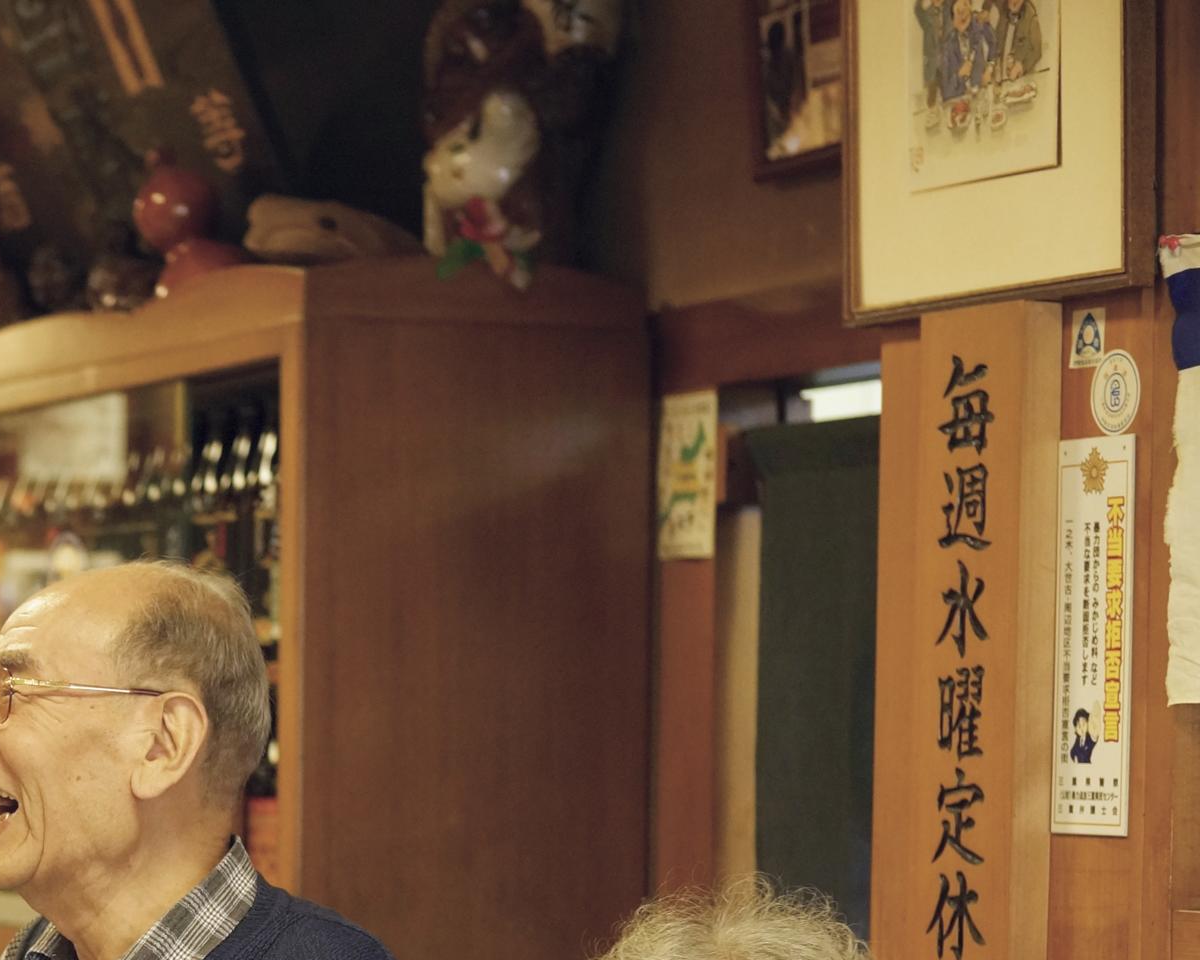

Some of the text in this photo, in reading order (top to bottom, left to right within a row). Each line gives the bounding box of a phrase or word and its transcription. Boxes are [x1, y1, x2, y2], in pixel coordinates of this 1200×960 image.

[1104, 496, 1125, 742] 不当要求拒否宣言
